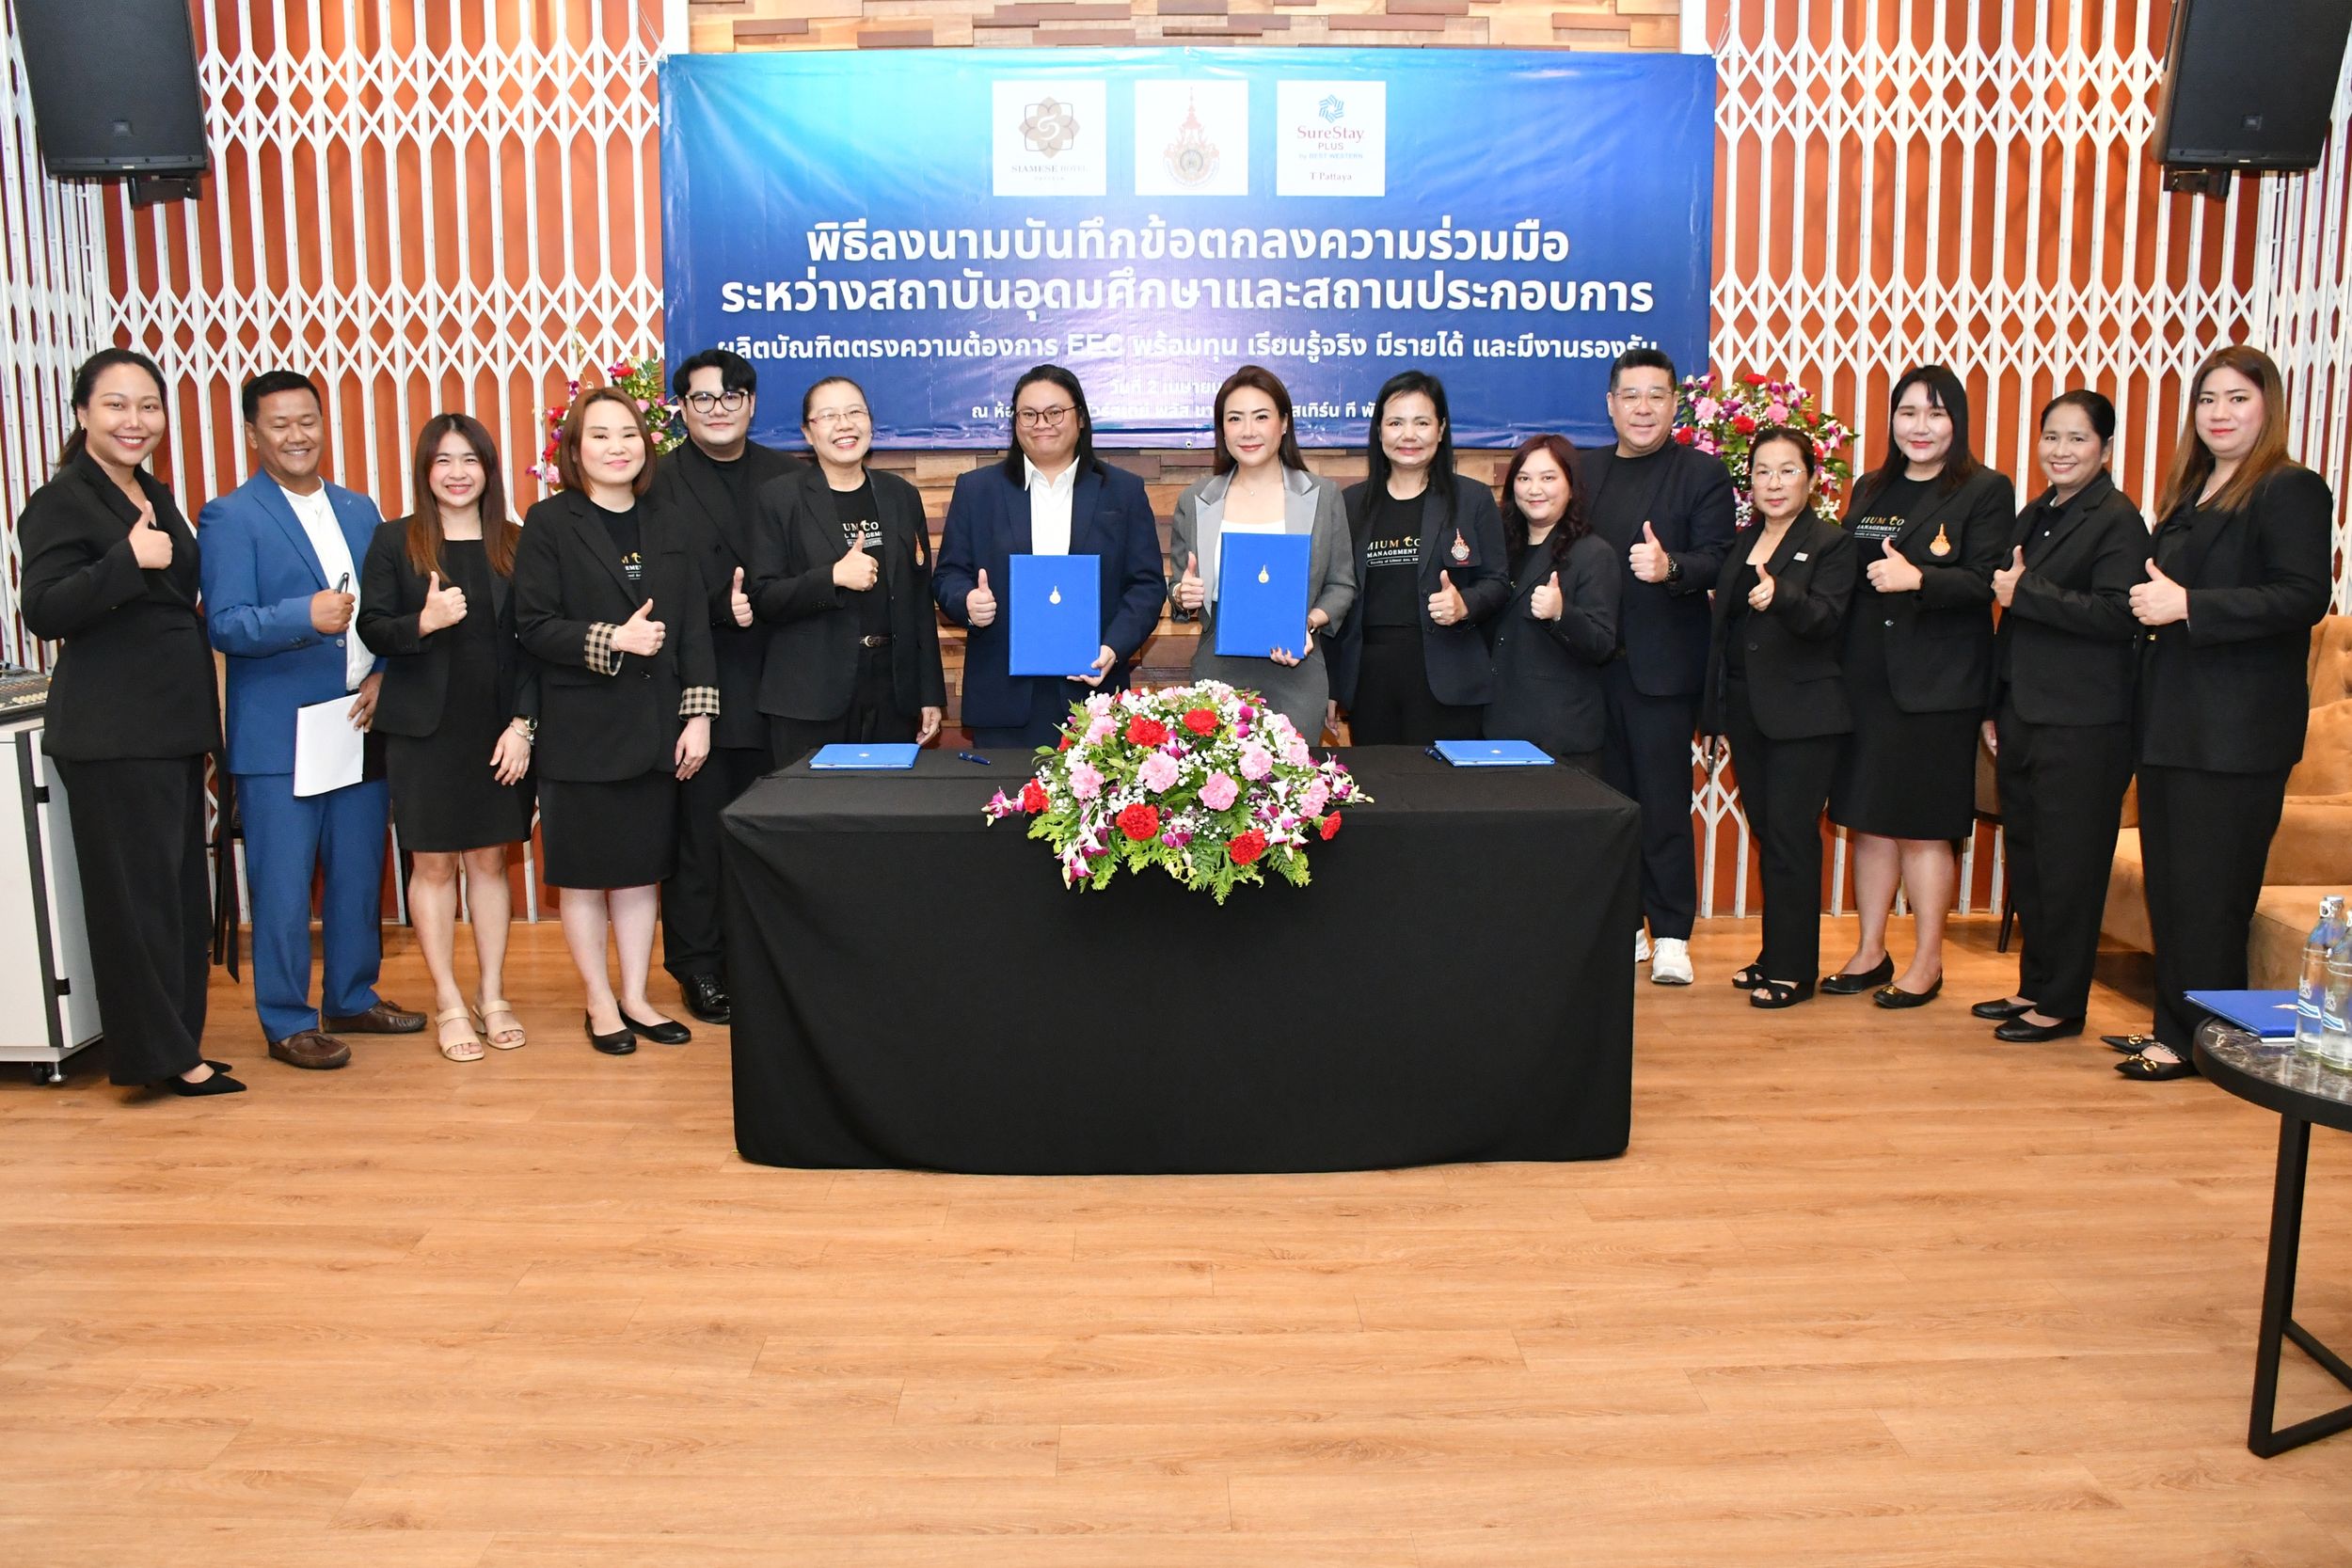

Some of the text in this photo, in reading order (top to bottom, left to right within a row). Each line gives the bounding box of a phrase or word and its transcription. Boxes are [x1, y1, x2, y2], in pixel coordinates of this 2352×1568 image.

[1297, 125, 1365, 144] SureStay
[1318, 142, 1344, 150] PLUS
[1010, 165, 1058, 173] SIAMESE
[1319, 171, 1353, 183] Pattaya
[806, 214, 1570, 262] พิธีลงนามบันทึกข้อตกลงความร่วมมือ
[722, 265, 1654, 322] ระหว่างสถาบันอุดมศึกษาและสถานประกอบการ
[1067, 333, 1123, 357] EEC
[1133, 330, 1238, 363] พร้อมทุน
[1248, 329, 1367, 363] เรียนรู้จริง
[1376, 330, 1464, 356] มีรายได้
[1148, 380, 1158, 394] 2
[972, 406, 988, 419] ณ
[1292, 402, 1340, 418] สเทิร์น
[1345, 401, 1357, 418] ที
